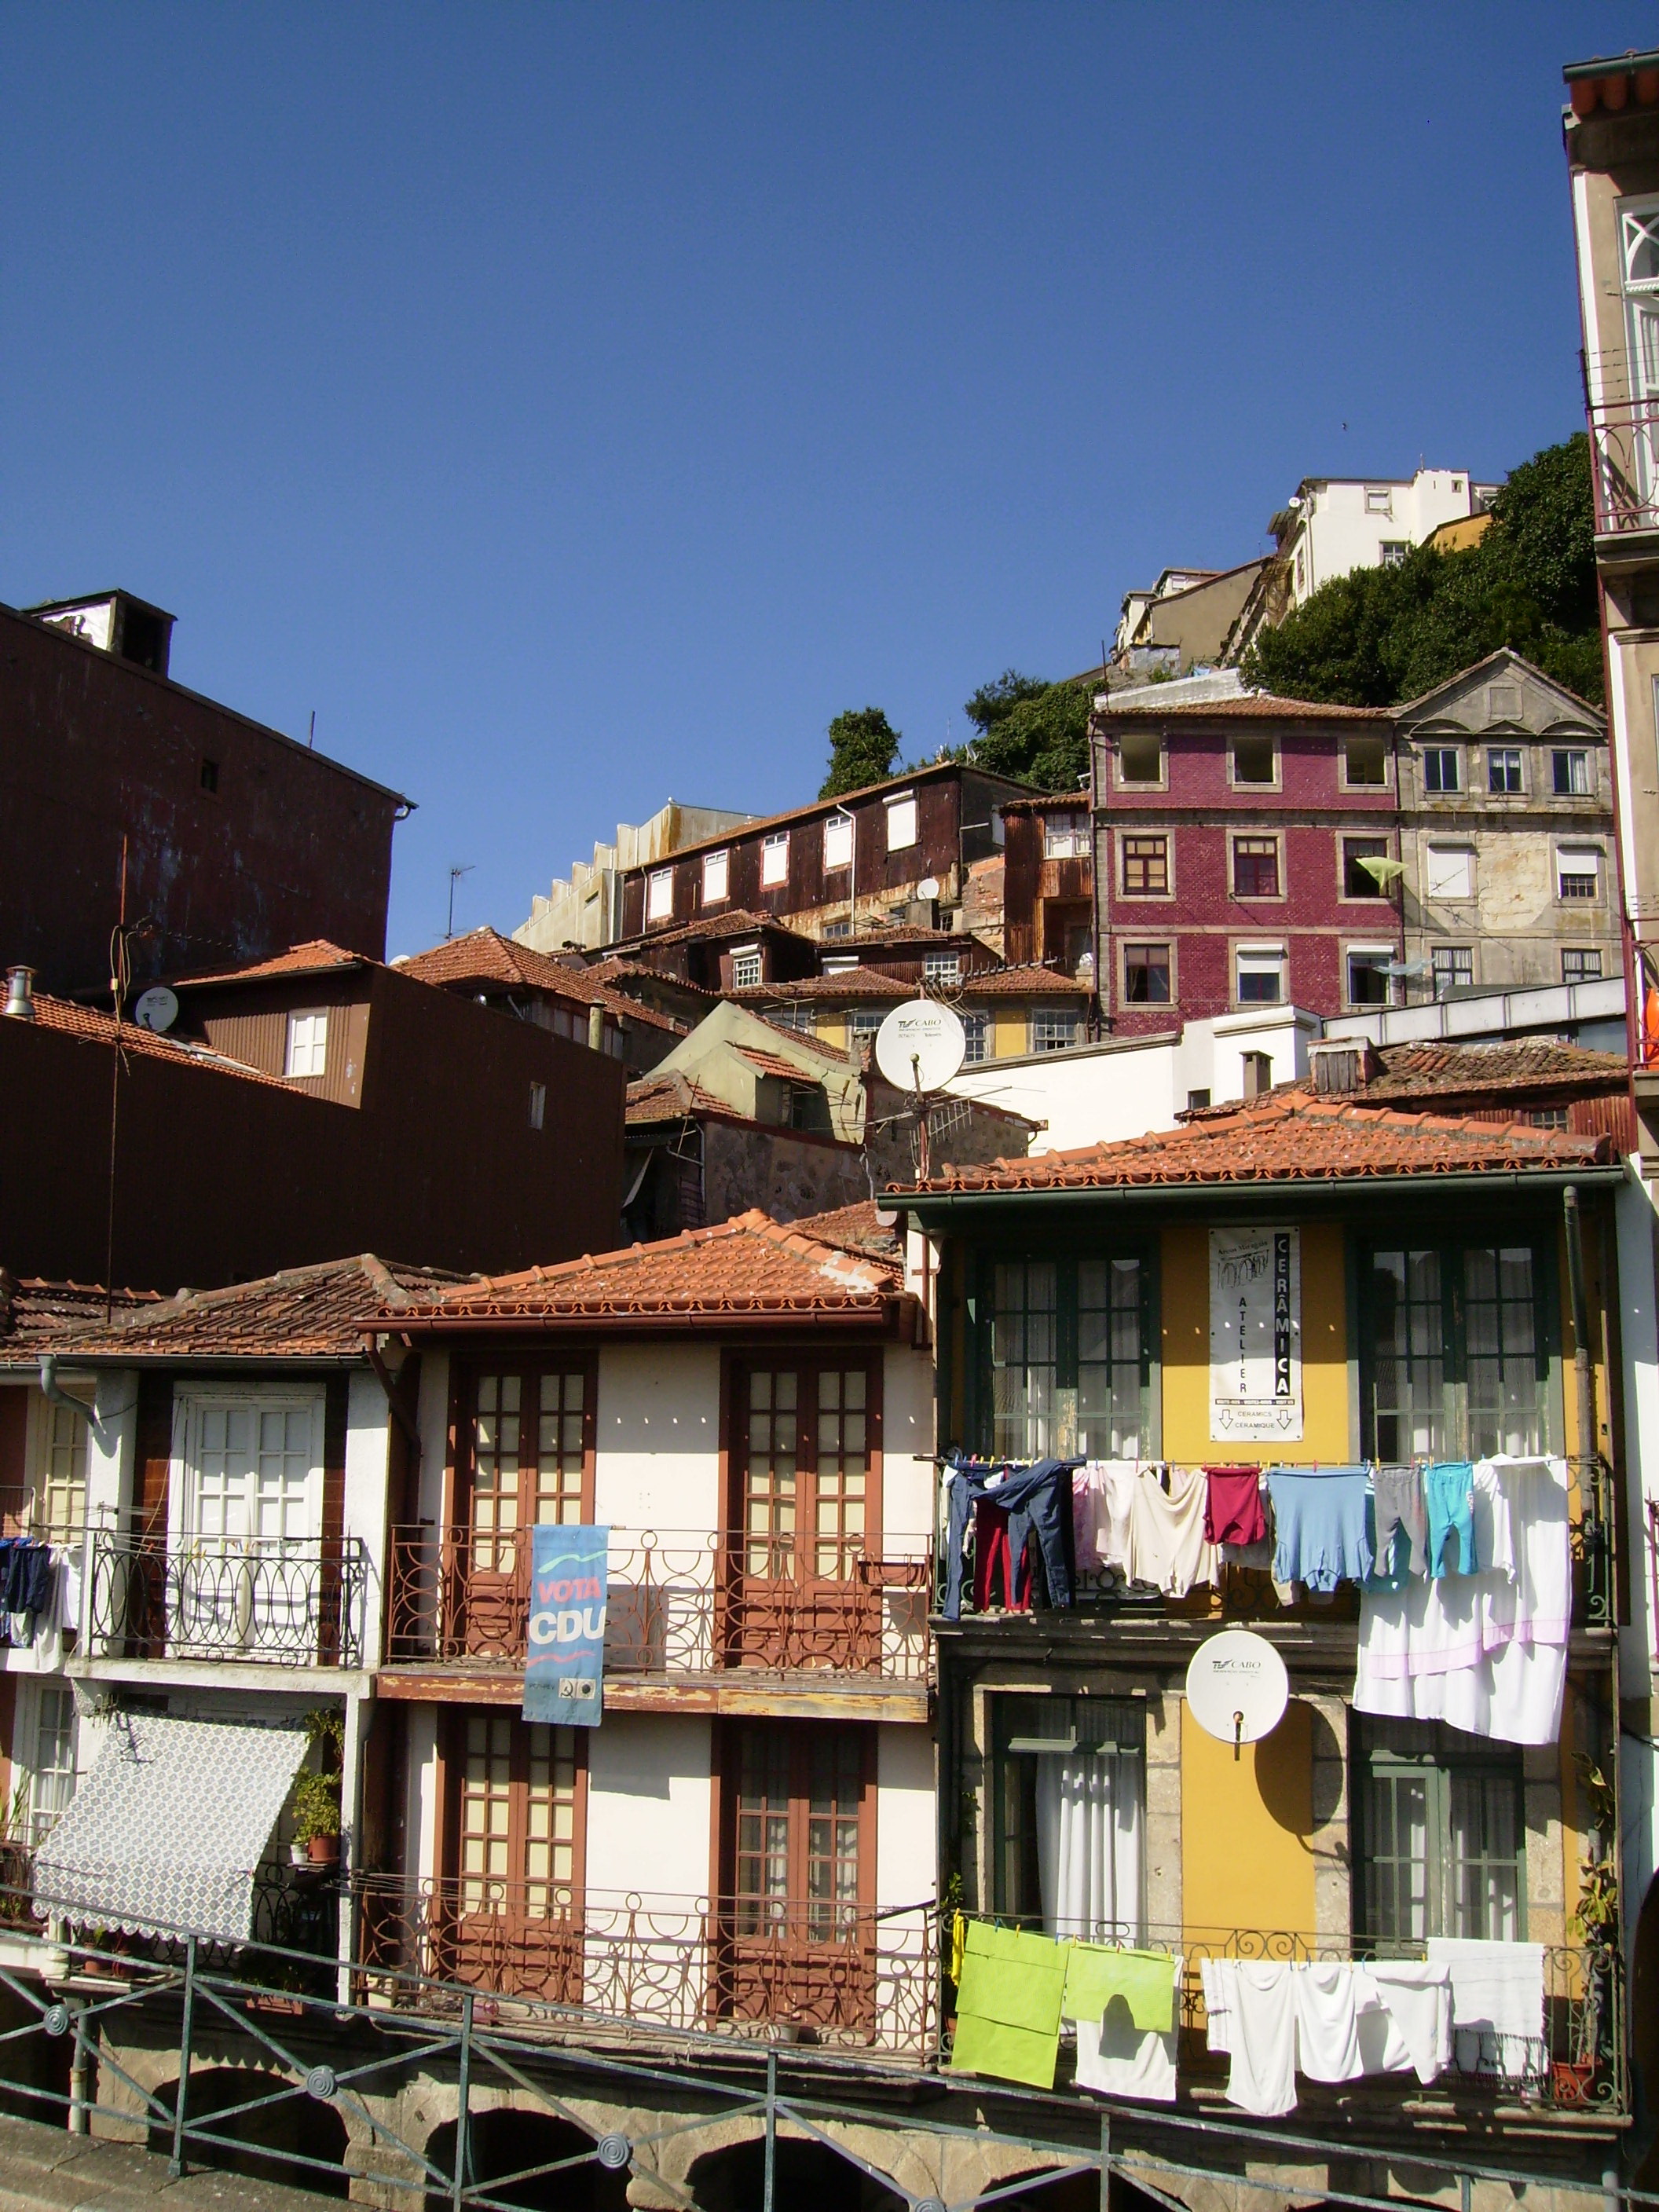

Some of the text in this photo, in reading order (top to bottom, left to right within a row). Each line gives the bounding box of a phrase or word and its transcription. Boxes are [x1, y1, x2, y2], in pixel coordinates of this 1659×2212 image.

[1276, 1239, 1289, 1394] CERÂMICA
[537, 1577, 602, 1604] VOTA
[529, 1606, 606, 1645] CDU
